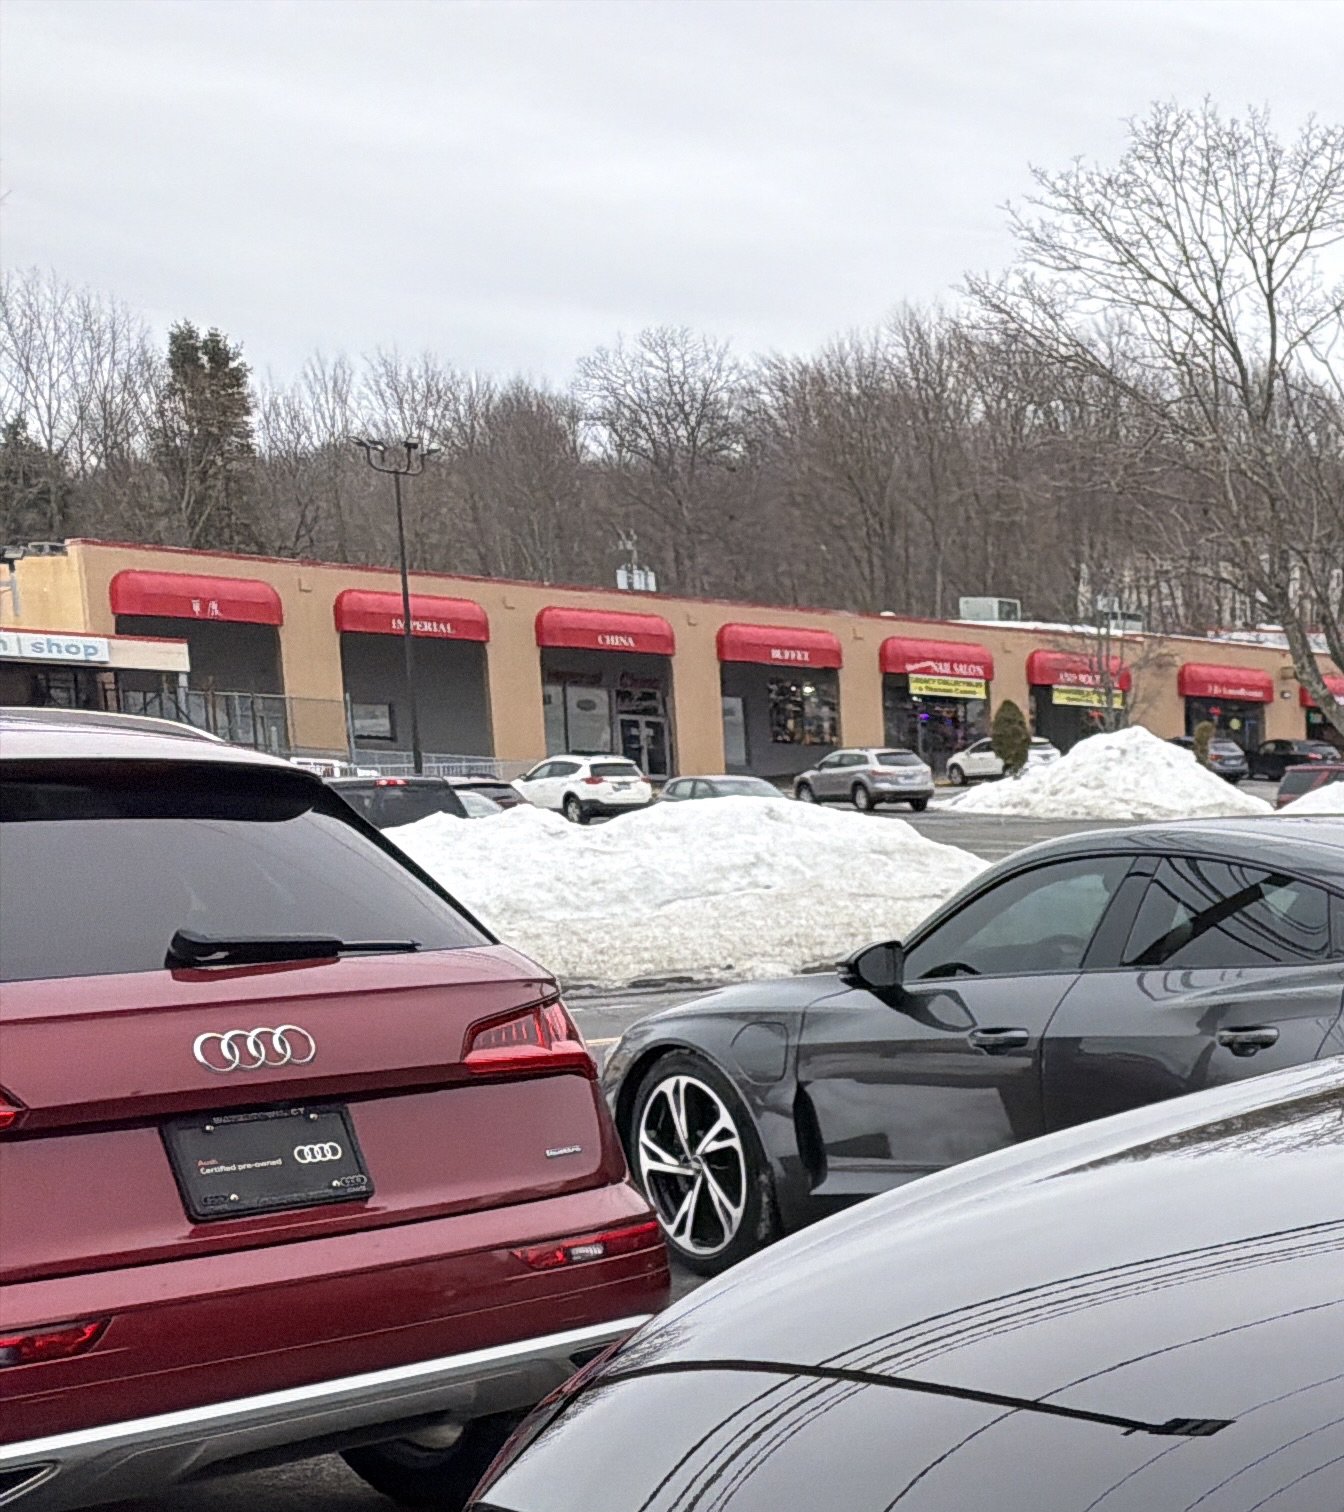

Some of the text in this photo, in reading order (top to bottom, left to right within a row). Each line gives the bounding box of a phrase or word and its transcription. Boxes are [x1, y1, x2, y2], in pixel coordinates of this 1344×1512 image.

[31, 637, 98, 660] shop
[597, 634, 635, 647] CHINA
[200, 1158, 283, 1175] Certified pre-owned
